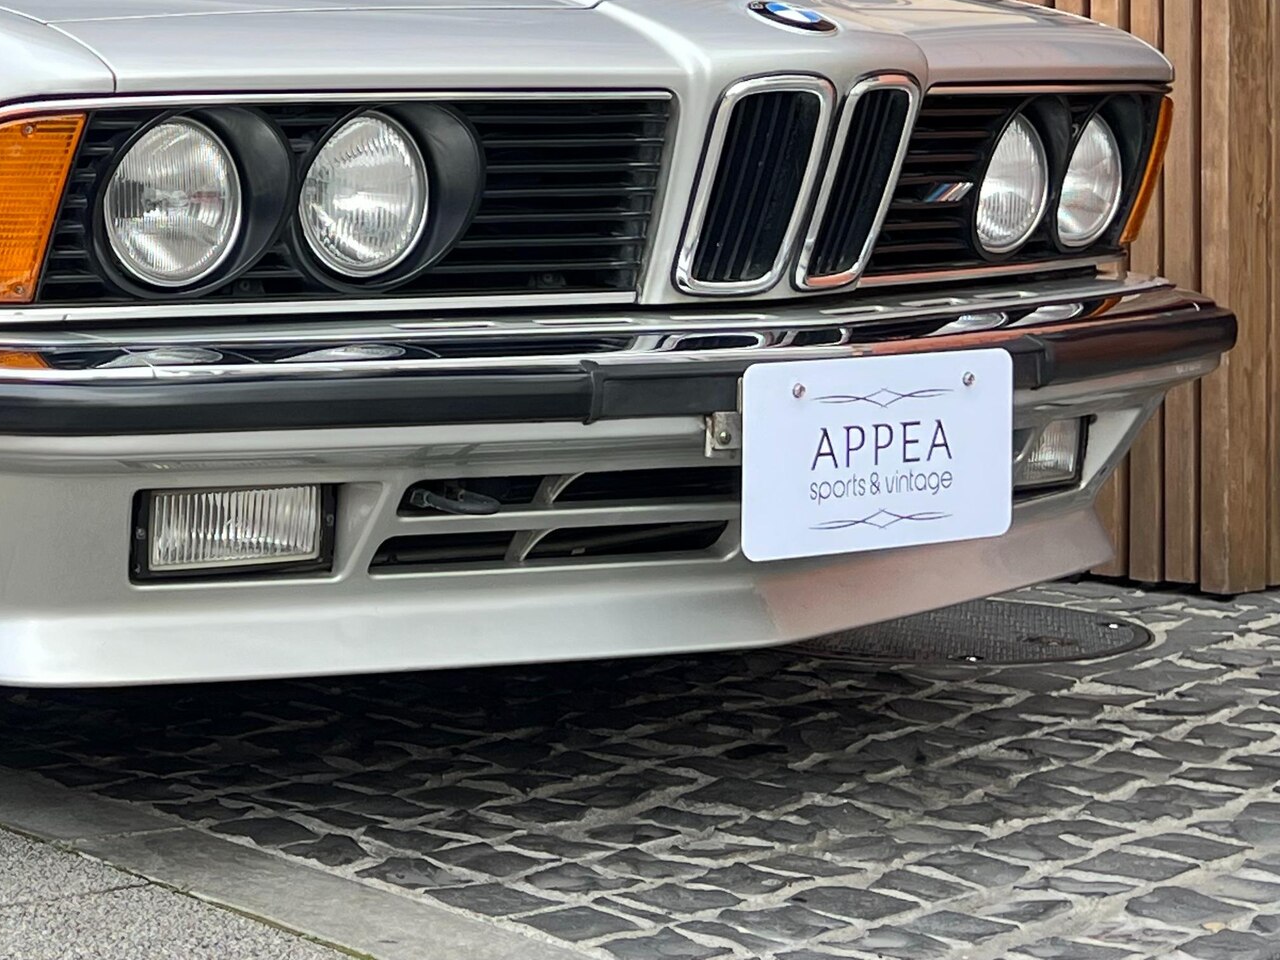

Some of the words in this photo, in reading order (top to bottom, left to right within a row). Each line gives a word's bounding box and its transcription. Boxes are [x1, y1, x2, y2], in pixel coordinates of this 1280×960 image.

[811, 419, 953, 471] APPEA
[809, 473, 866, 505] sports
[869, 472, 881, 495] &
[885, 469, 953, 496] vintage
